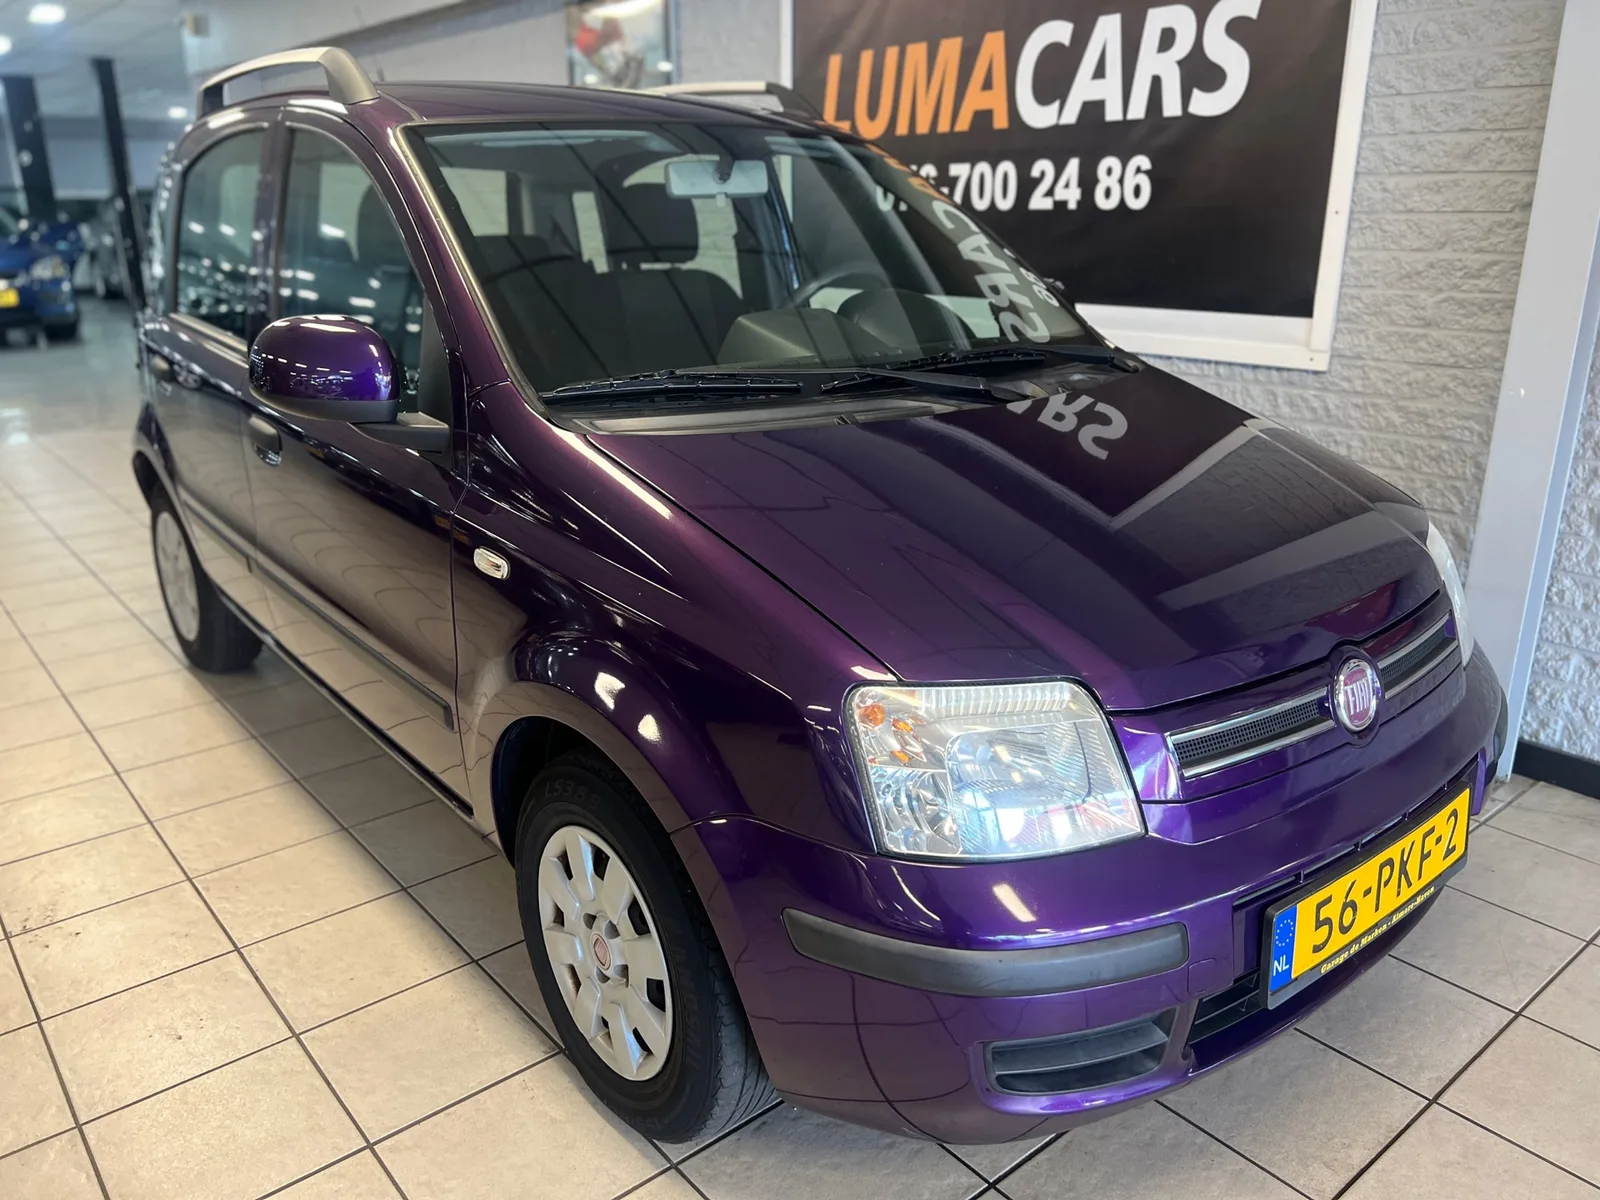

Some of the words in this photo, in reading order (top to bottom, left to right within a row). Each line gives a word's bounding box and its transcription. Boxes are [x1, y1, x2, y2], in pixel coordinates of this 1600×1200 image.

[823, 0, 1262, 141] LUMACARS
[875, 161, 1017, 212] -700
[1028, 157, 1081, 211] 24
[1094, 154, 1152, 211] 86
[1344, 676, 1371, 716] FIAT
[1311, 807, 1459, 955] 56-PKF-2
[1272, 952, 1290, 977] NL
[1320, 950, 1349, 974] Garage
[1349, 943, 1360, 954] de
